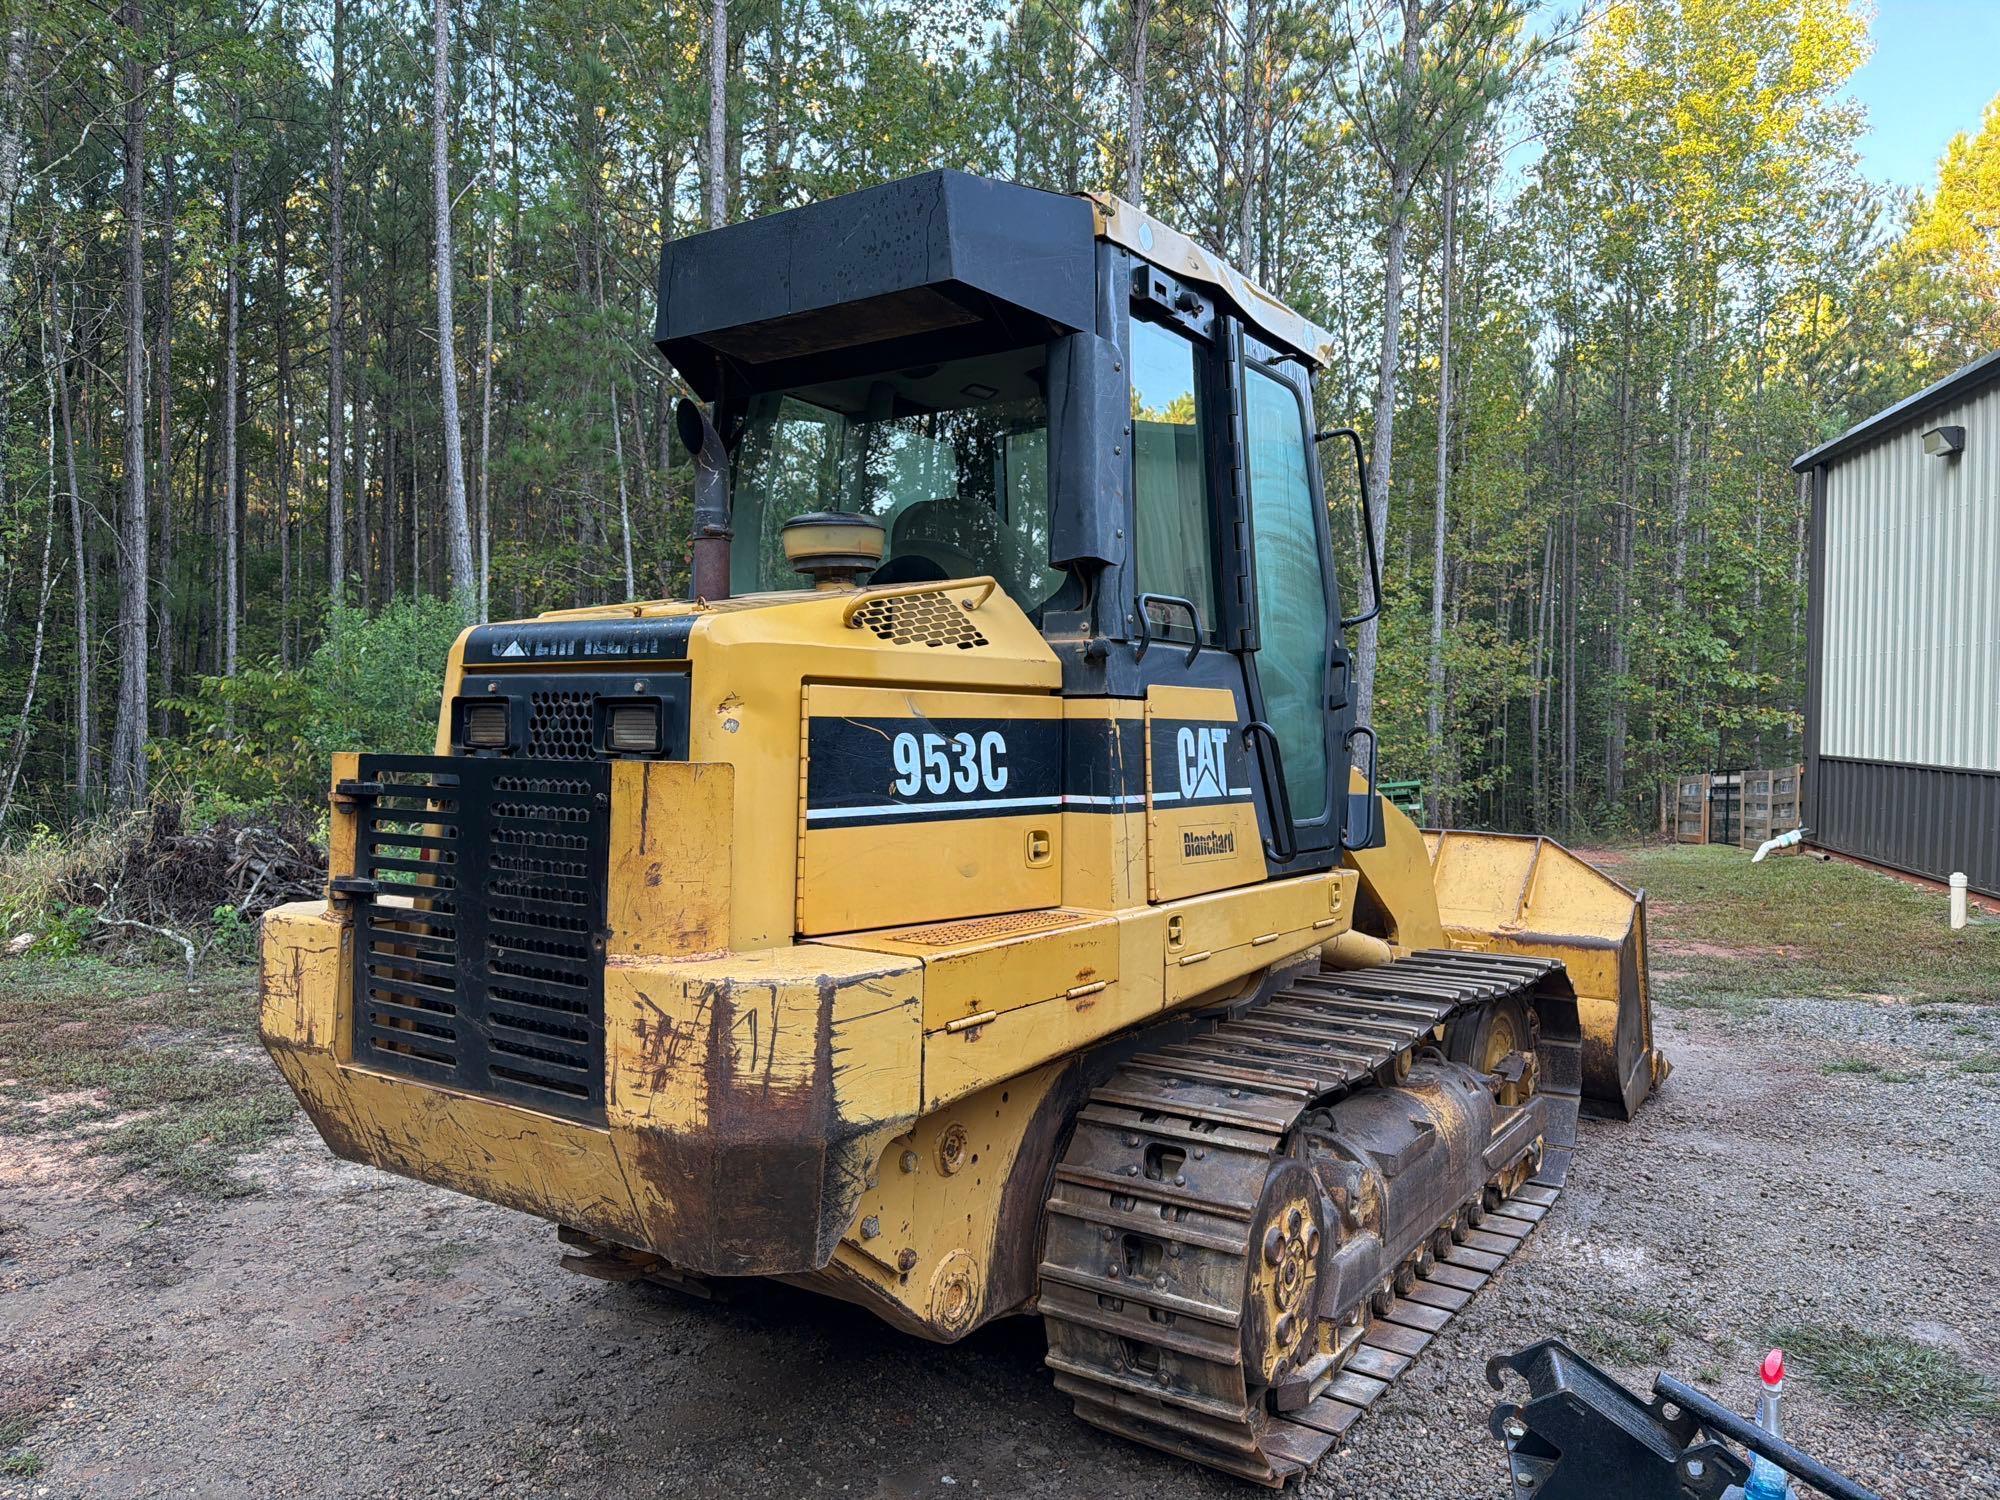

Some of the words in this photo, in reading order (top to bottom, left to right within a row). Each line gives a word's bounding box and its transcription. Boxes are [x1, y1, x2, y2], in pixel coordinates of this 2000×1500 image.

[893, 731, 1008, 796] 953C
[1177, 727, 1228, 798] CAT
[1184, 830, 1234, 857] Blanchard
